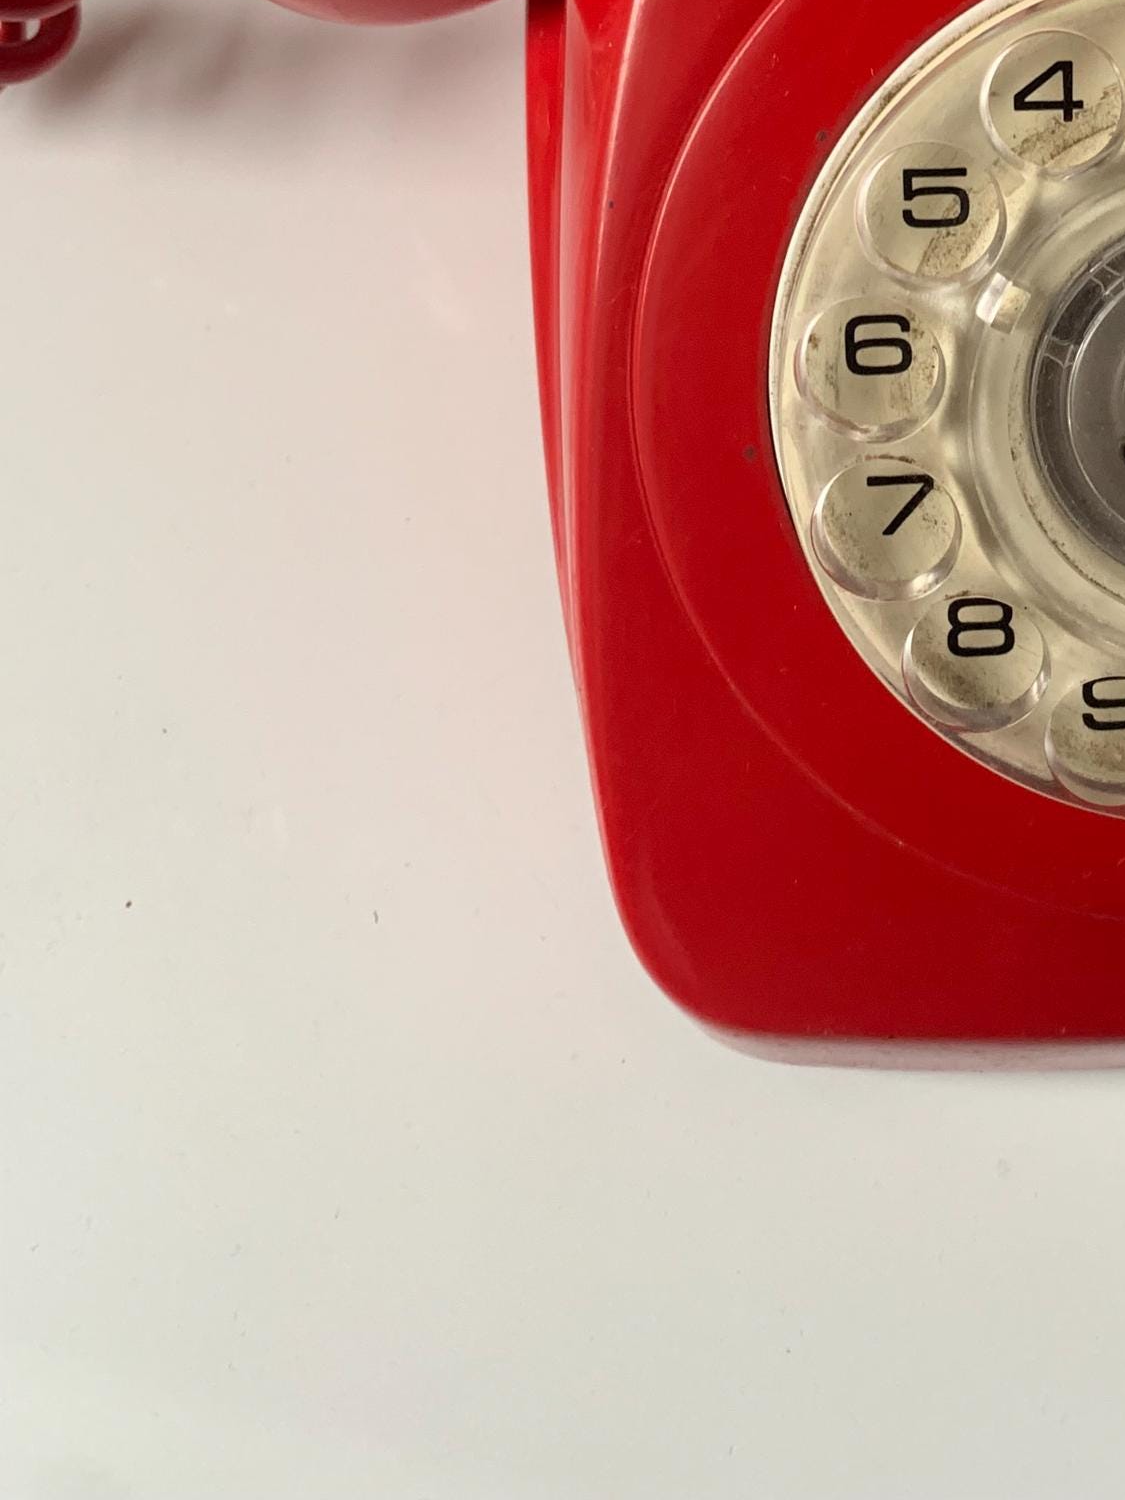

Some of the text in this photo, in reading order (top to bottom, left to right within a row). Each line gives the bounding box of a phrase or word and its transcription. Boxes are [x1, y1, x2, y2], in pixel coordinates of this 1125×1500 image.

[1013, 60, 1085, 122] 4
[902, 167, 970, 229] 5
[844, 314, 913, 376] 6
[866, 474, 934, 536] 7
[947, 597, 1015, 658] 8
